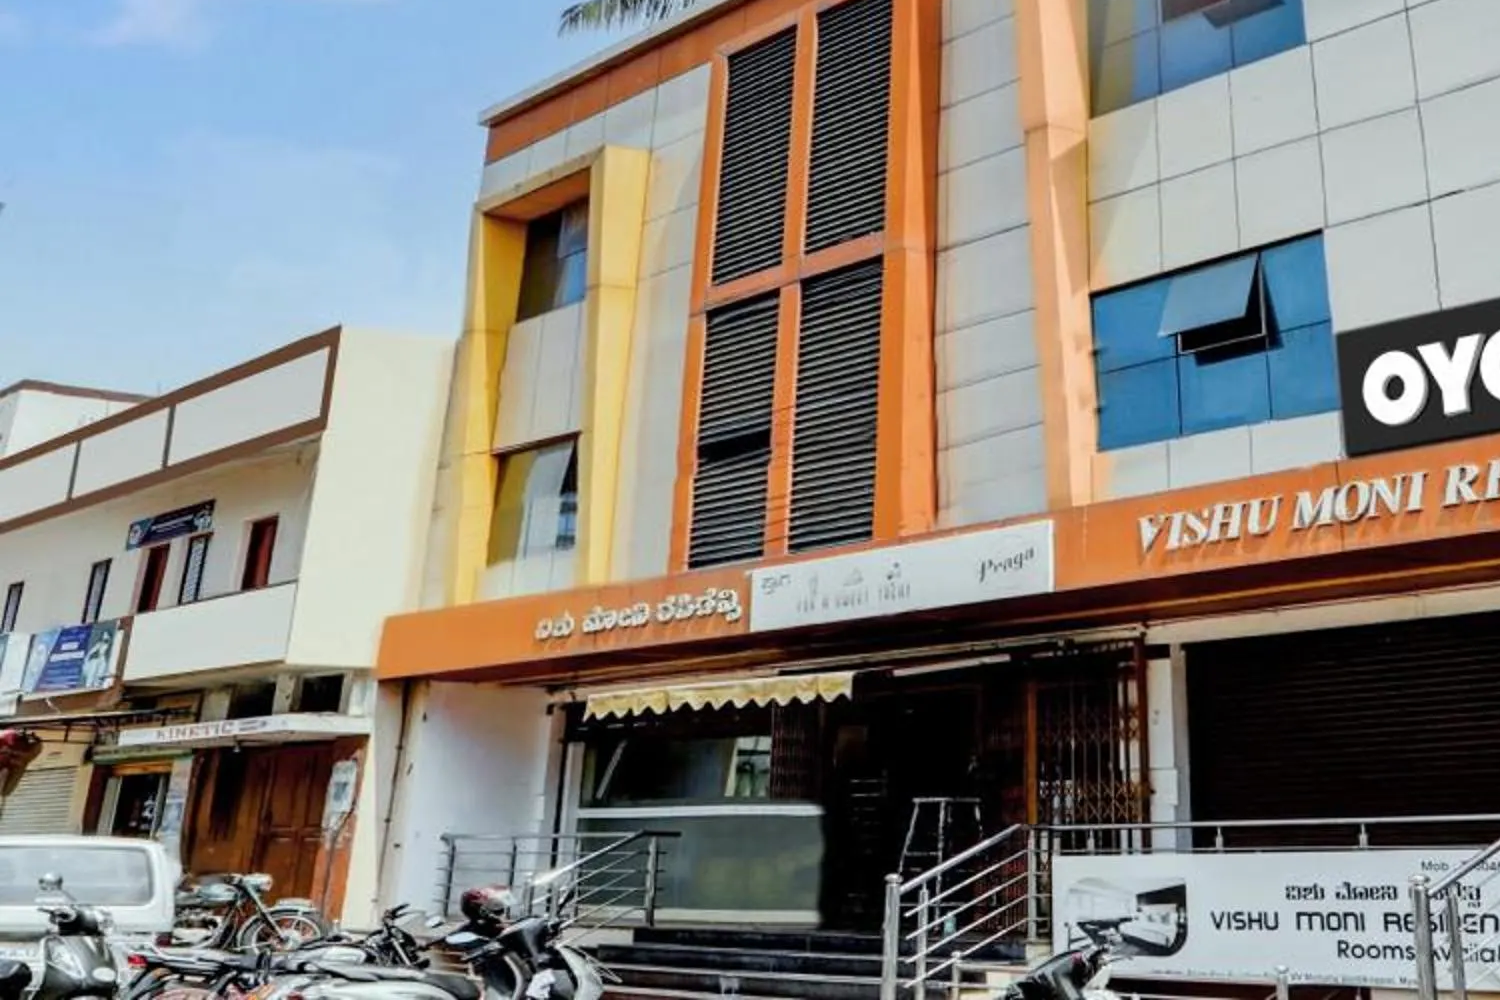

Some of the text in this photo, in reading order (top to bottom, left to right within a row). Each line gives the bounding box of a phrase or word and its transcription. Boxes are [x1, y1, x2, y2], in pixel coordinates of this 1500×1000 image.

[1138, 496, 1283, 553] VISHU
[1291, 470, 1428, 530] MONI
[979, 546, 1034, 582] Praga
[1210, 911, 1279, 931] VISHU
[1337, 939, 1416, 961] Rooms
